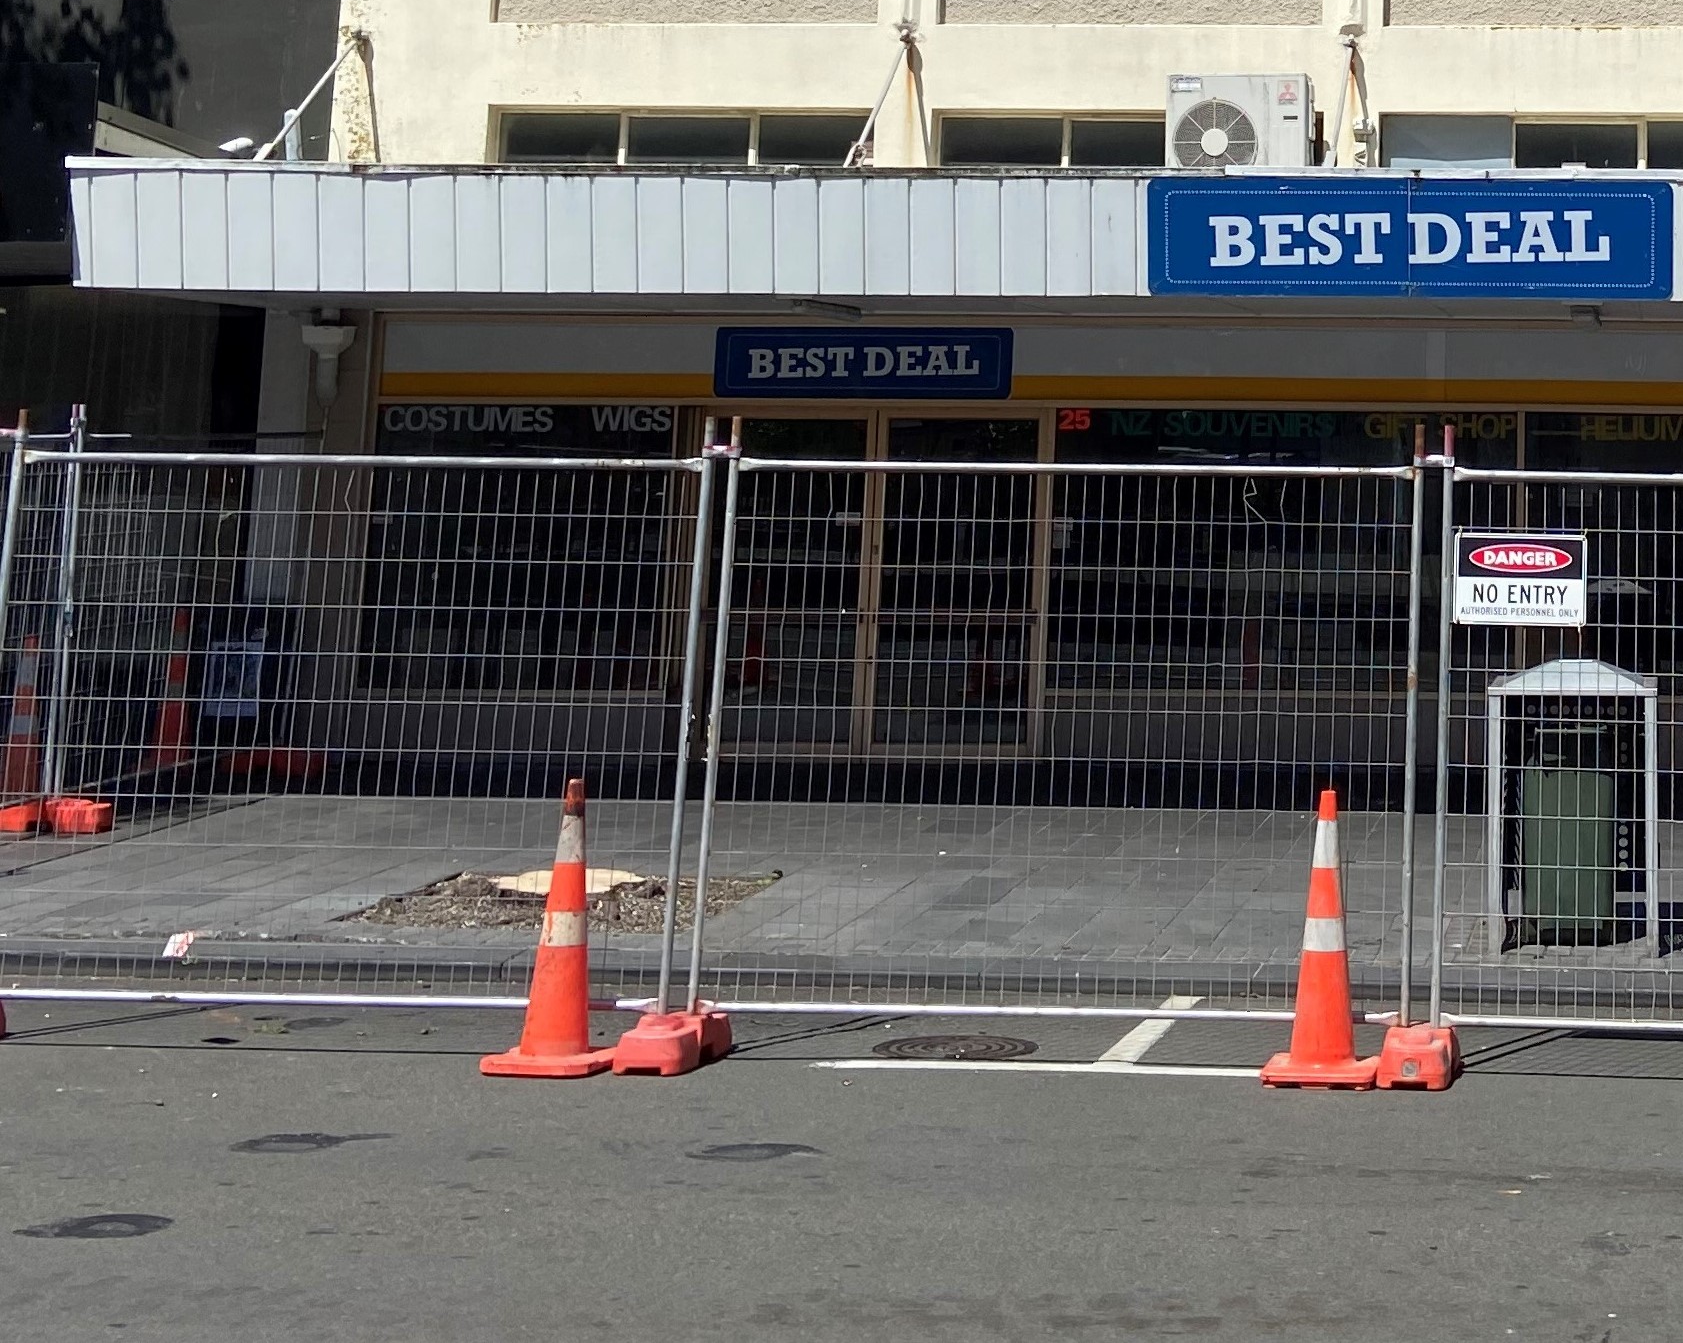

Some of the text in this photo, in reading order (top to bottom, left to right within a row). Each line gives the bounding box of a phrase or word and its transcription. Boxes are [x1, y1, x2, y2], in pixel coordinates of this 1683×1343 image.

[1209, 210, 1610, 267] BEST DEAL
[748, 344, 980, 379] BEST DEAL
[384, 406, 672, 433] COSTUMES WIGS
[1059, 409, 1092, 432] 25
[1109, 411, 1336, 438] NZ SOUVENIRS
[1484, 551, 1557, 566] DANGER
[1473, 584, 1568, 605] NO ENTRY
[1461, 607, 1579, 617] AUTHORISED PERSONNEL ONLY
